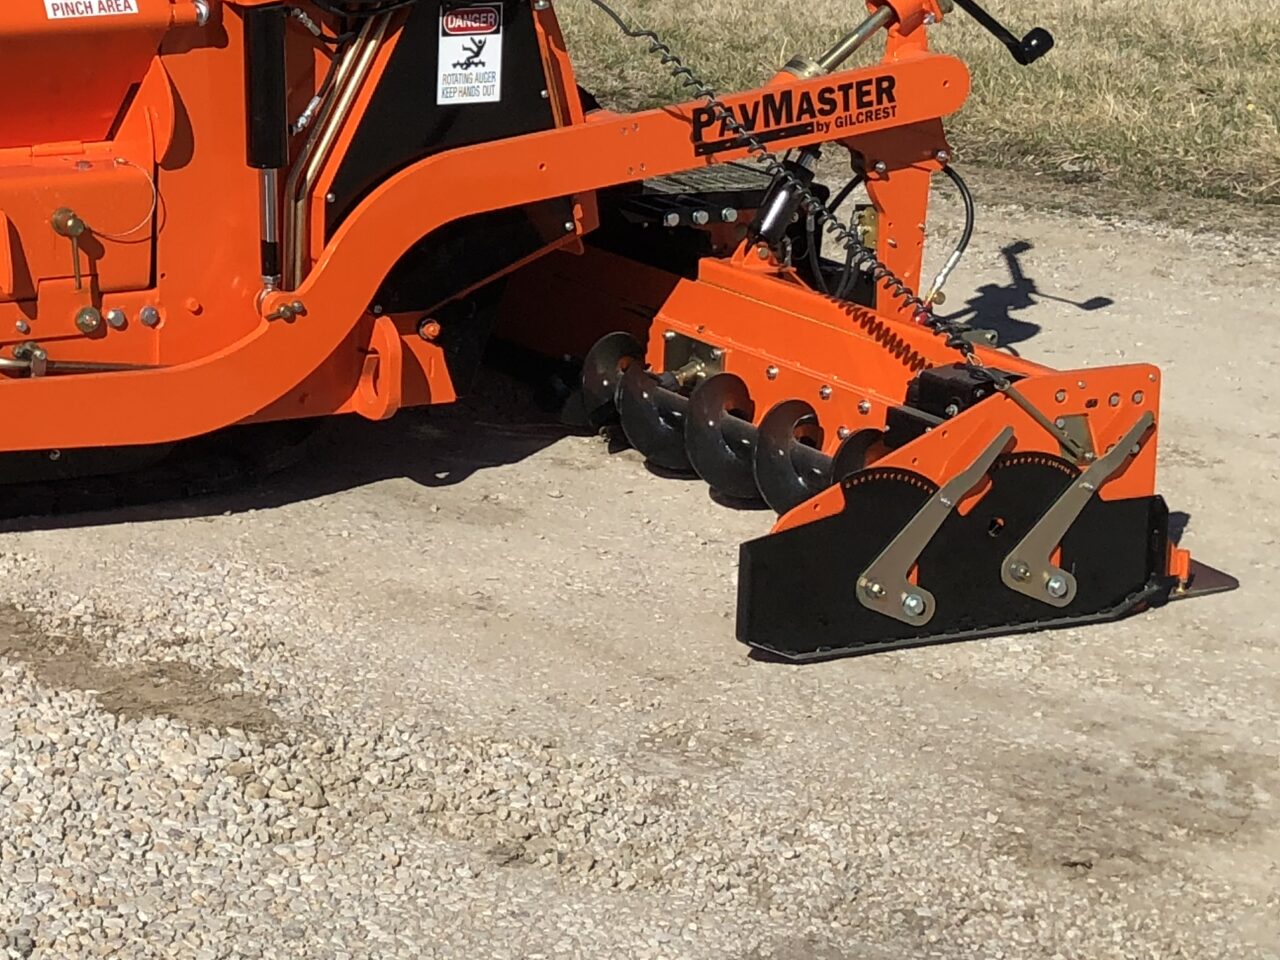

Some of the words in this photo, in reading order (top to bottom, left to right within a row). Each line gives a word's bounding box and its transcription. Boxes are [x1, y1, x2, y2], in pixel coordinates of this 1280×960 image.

[51, 1, 93, 16] PINCH
[448, 13, 495, 28] DANGER
[442, 72, 473, 85] ROTATING
[475, 71, 496, 83] AUGER
[441, 86, 457, 98] KEEP
[458, 85, 480, 97] HANDS
[482, 84, 496, 96] OUT
[816, 120, 832, 133] by
[834, 105, 897, 129] GILCREST
